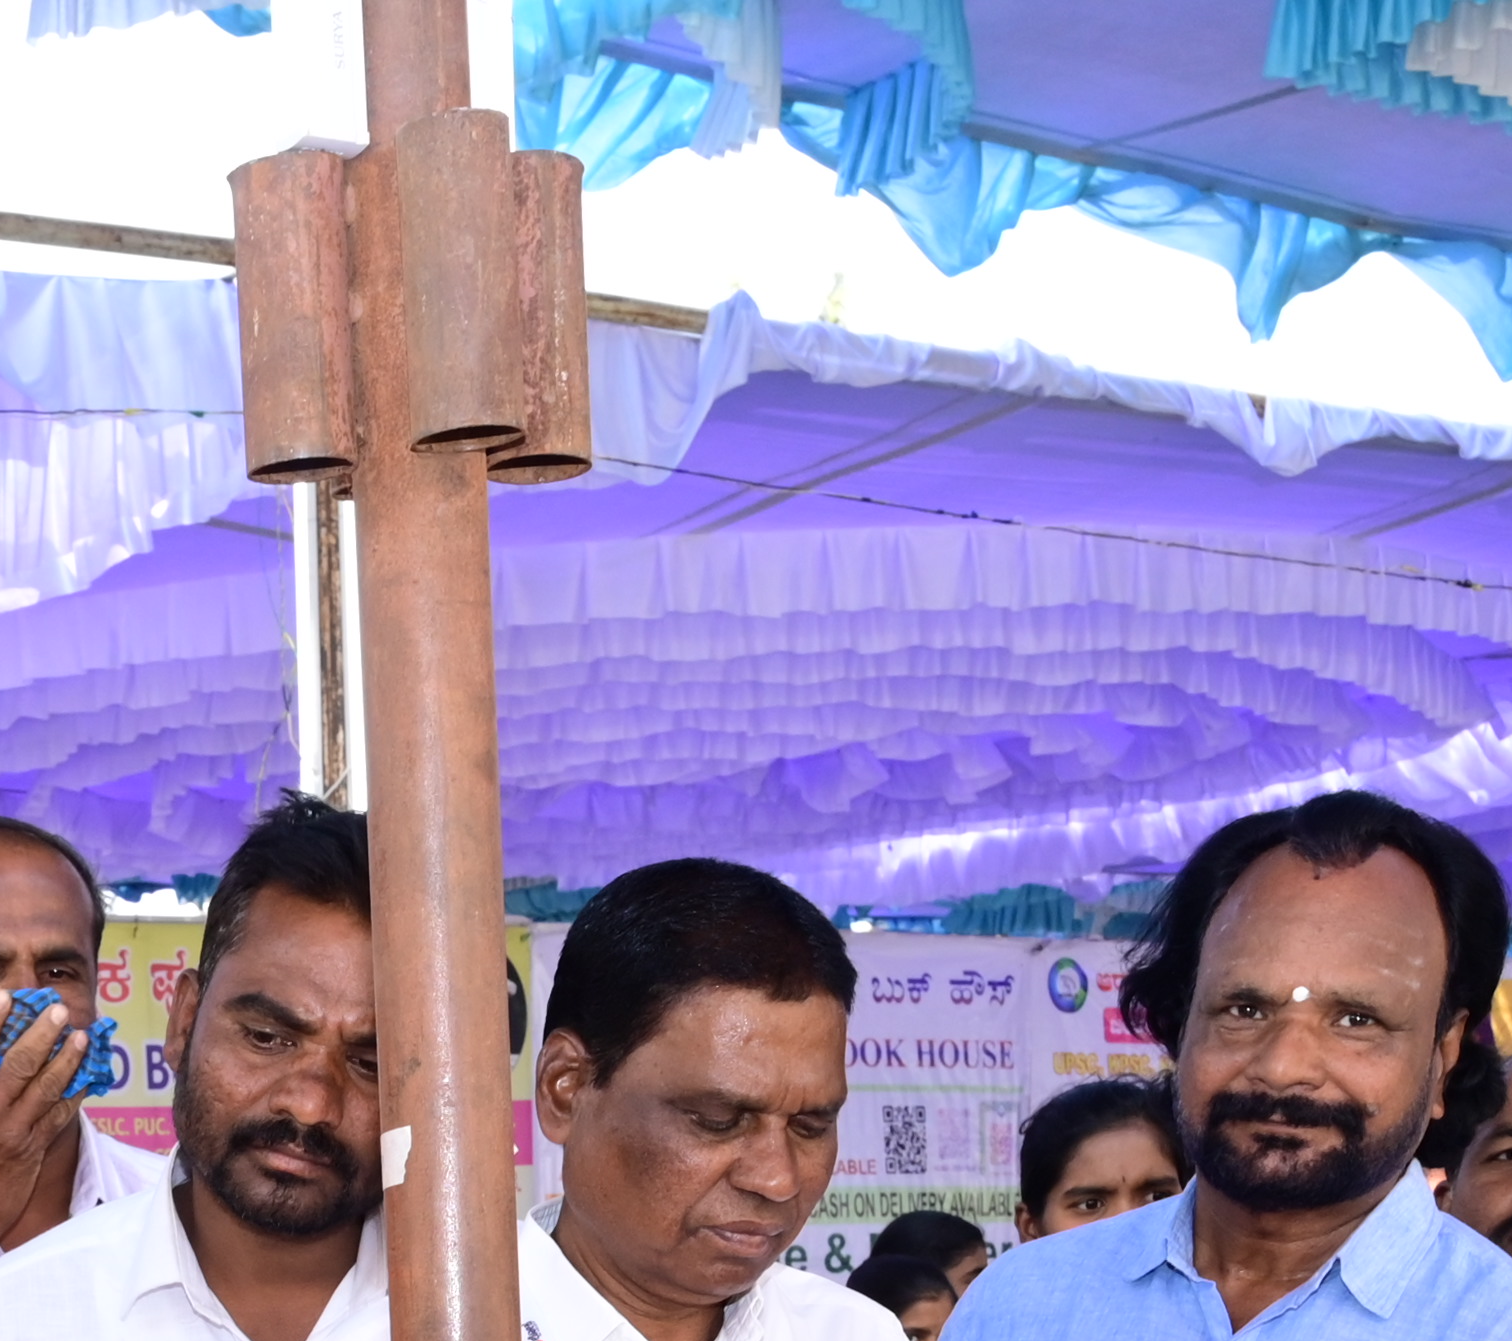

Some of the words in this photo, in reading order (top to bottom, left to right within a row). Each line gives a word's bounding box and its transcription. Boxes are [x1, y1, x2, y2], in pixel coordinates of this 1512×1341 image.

[871, 974, 932, 1004] ಬುಕ್
[949, 970, 1016, 1006] ಹೌಸ್
[847, 1039, 905, 1070] OOK
[917, 1038, 1015, 1071] HOUSE
[854, 1193, 875, 1217] ON
[877, 1189, 946, 1217] DELIVERY
